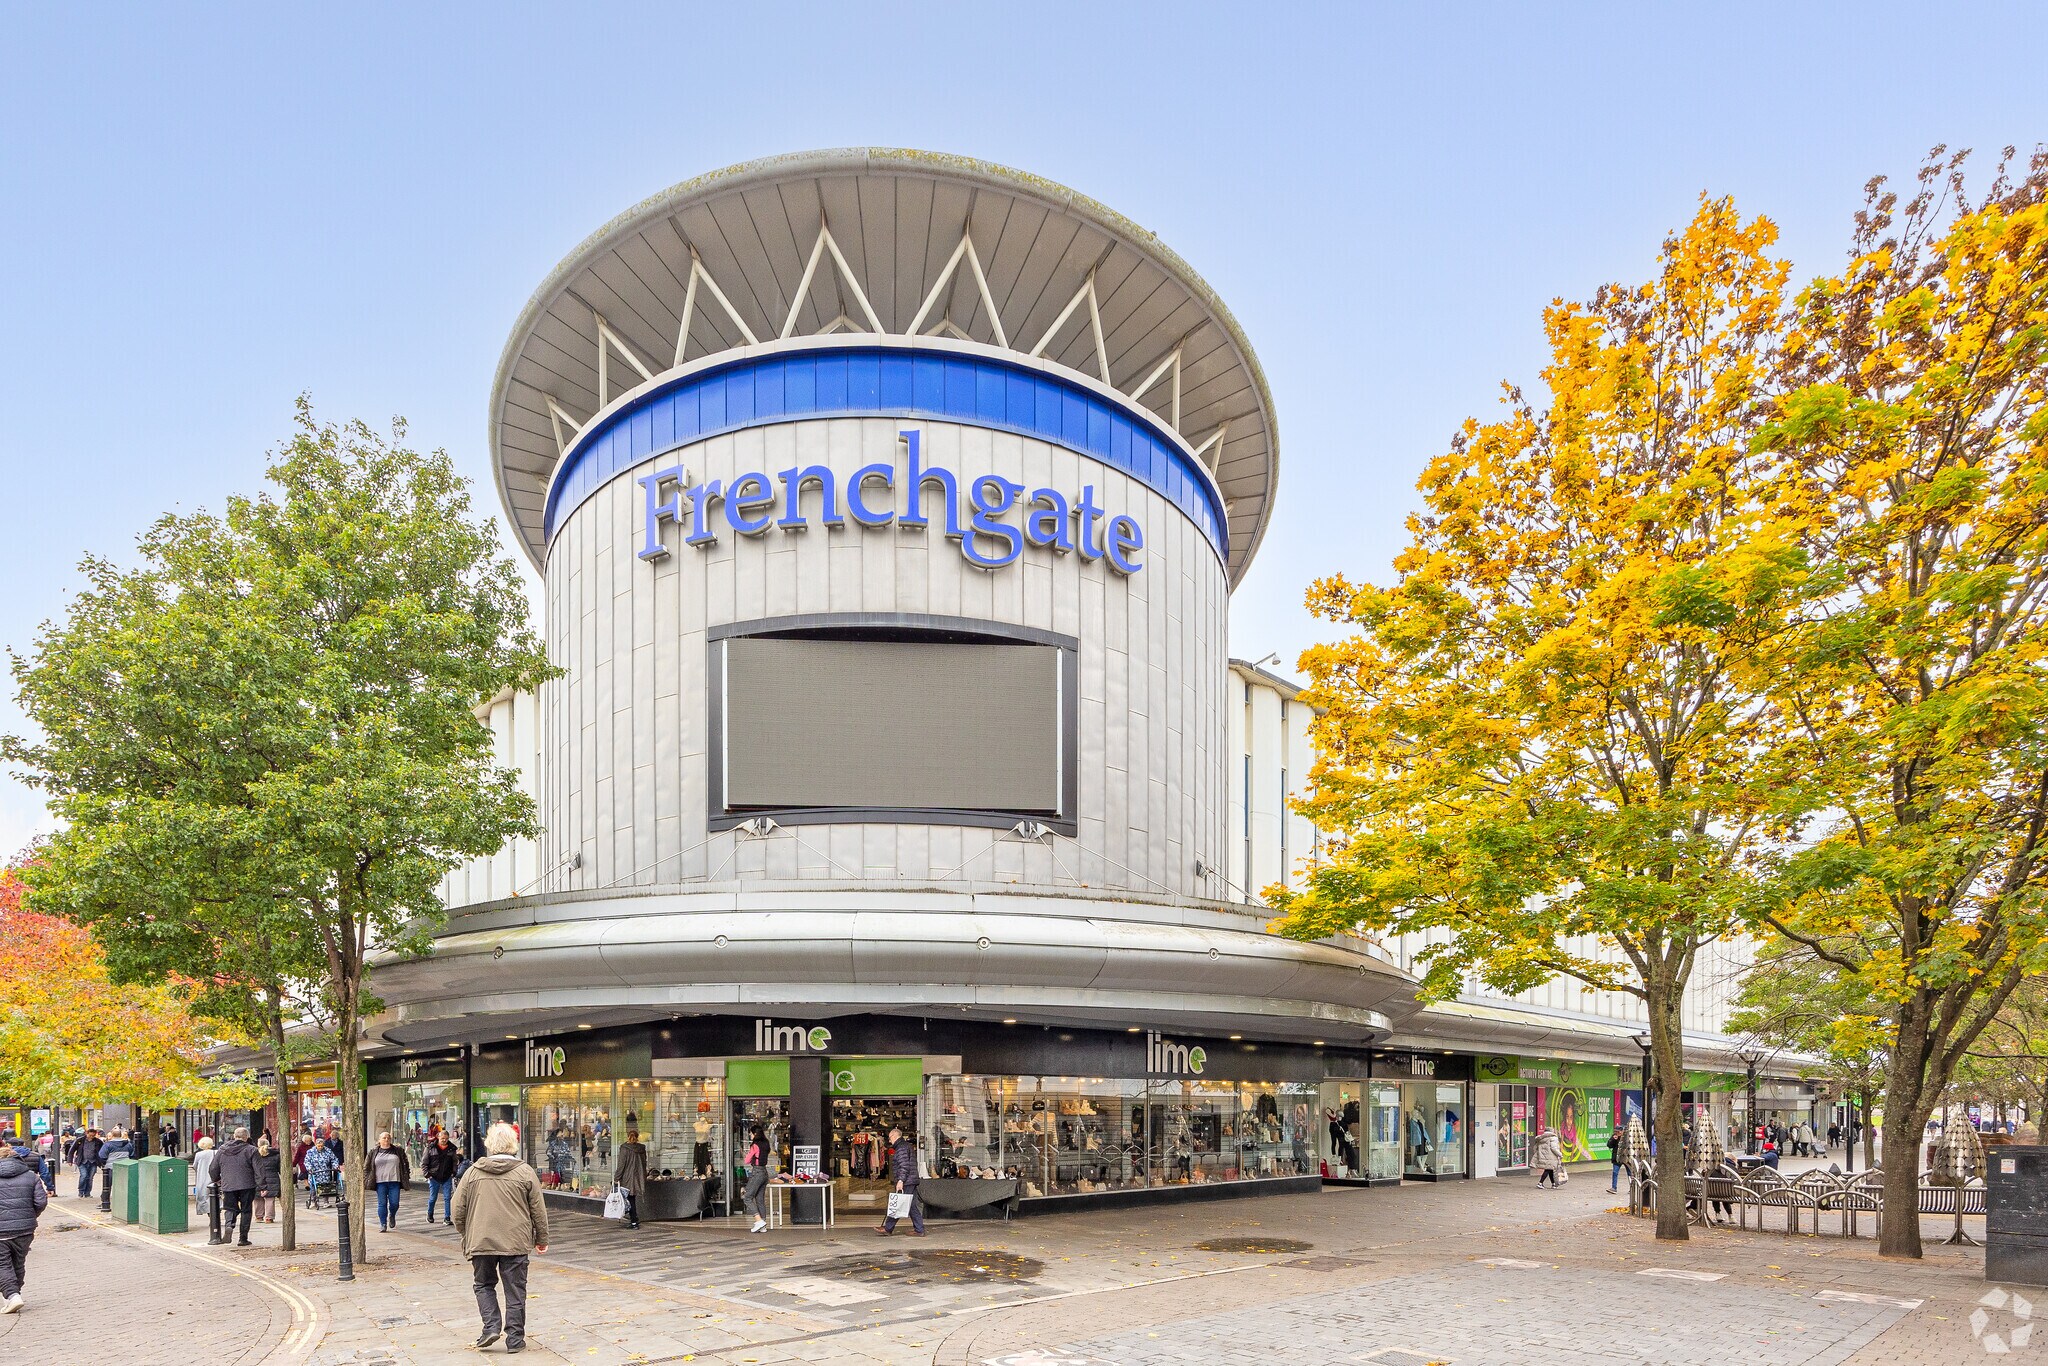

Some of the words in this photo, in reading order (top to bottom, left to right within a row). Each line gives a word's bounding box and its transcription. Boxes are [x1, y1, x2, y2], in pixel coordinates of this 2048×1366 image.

[638, 429, 1144, 576] Frenchgate
[755, 1019, 832, 1051] lime
[525, 1040, 566, 1078] lime
[1147, 1031, 1207, 1075] lime
[1411, 1054, 1435, 1076] lime
[1588, 1097, 1597, 1113] GET
[1597, 1097, 1611, 1113] SOME
[1588, 1113, 1597, 1129] AIR
[1596, 1113, 1608, 1129] TIME
[888, 1194, 899, 1217] M&S
